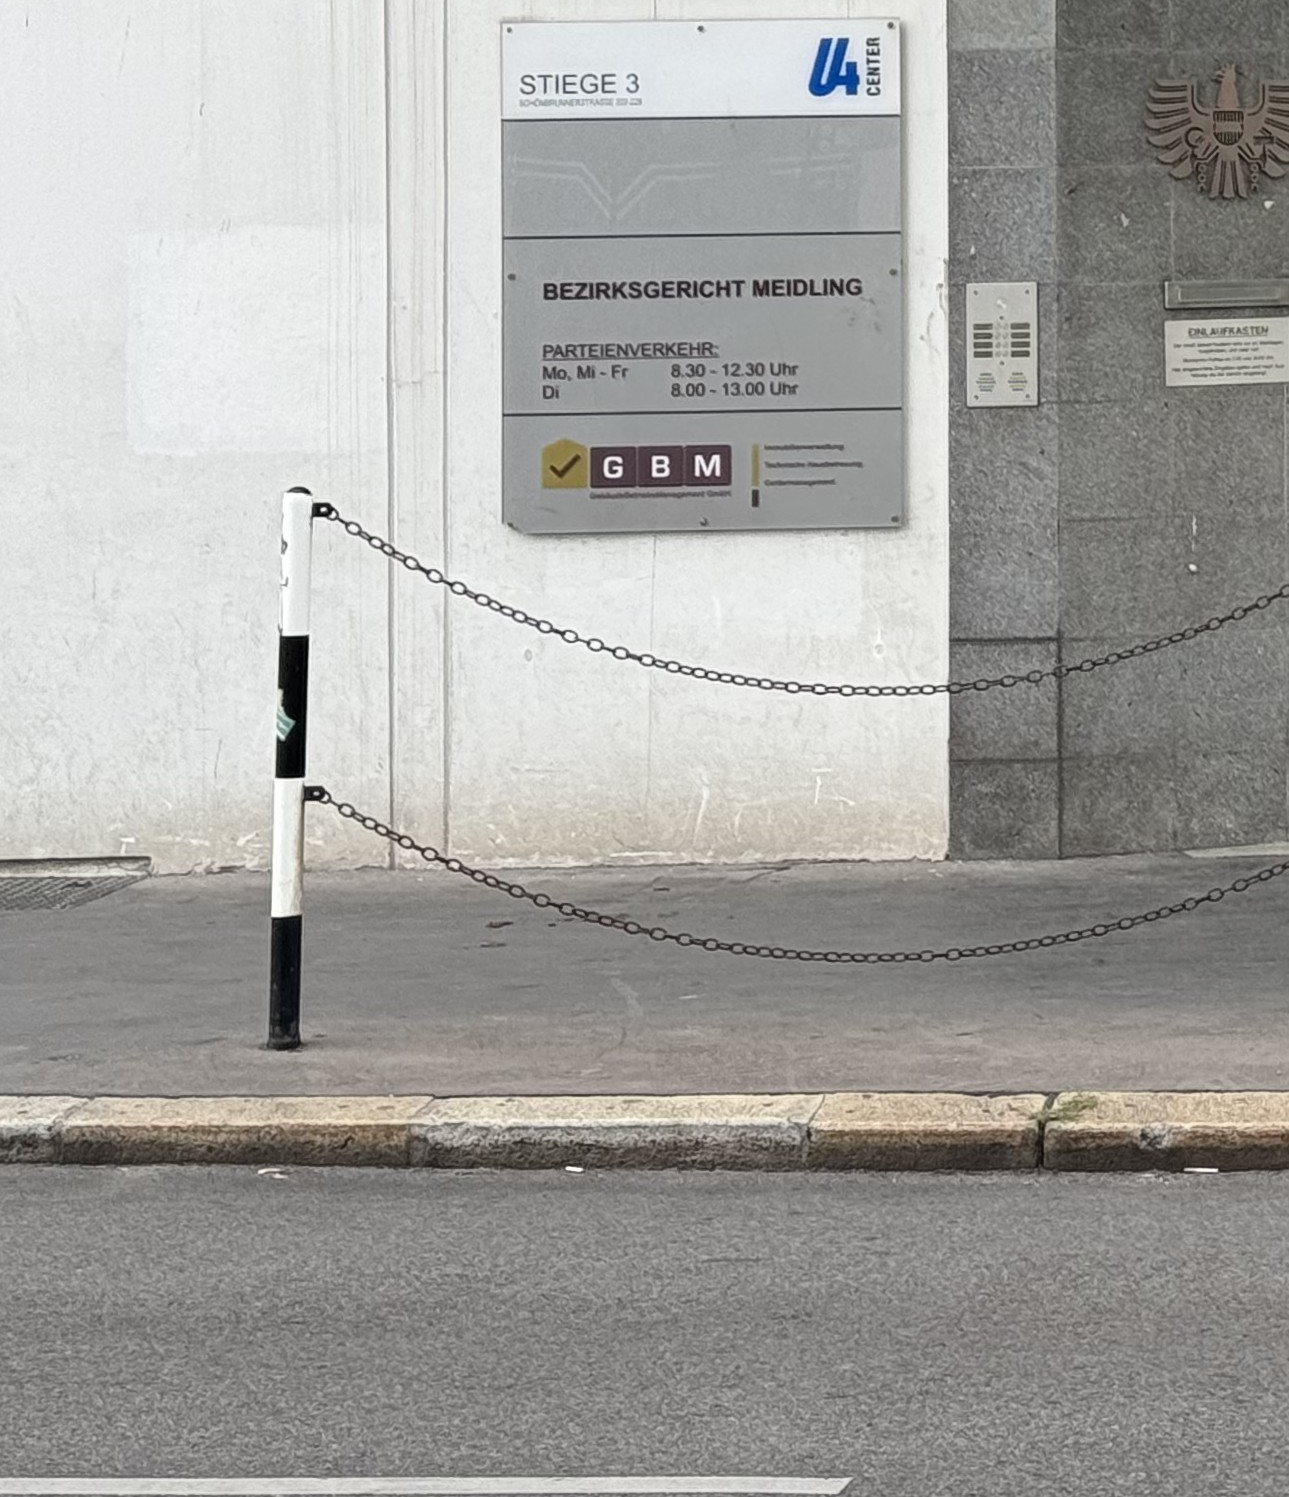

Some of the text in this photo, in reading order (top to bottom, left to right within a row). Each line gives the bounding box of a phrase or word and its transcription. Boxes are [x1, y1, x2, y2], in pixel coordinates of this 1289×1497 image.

[866, 37, 881, 96] CENTER
[519, 72, 640, 95] STIEGE 3
[542, 277, 863, 301] BEZIRKSGERICHT MEIDLING
[1187, 325, 1269, 337] EINLAUFKASTEN
[542, 342, 719, 360] PARTEIENVERKEHR:
[542, 365, 573, 381] Mo,
[576, 365, 596, 380] Mi
[611, 364, 629, 379] Fr
[670, 363, 706, 378] 8.30
[722, 362, 765, 377] 12.30
[769, 362, 799, 377] Uhr
[542, 385, 560, 400] Di
[670, 382, 708, 398] 8.00
[722, 381, 765, 397] 13.00
[769, 381, 799, 396] Uhr
